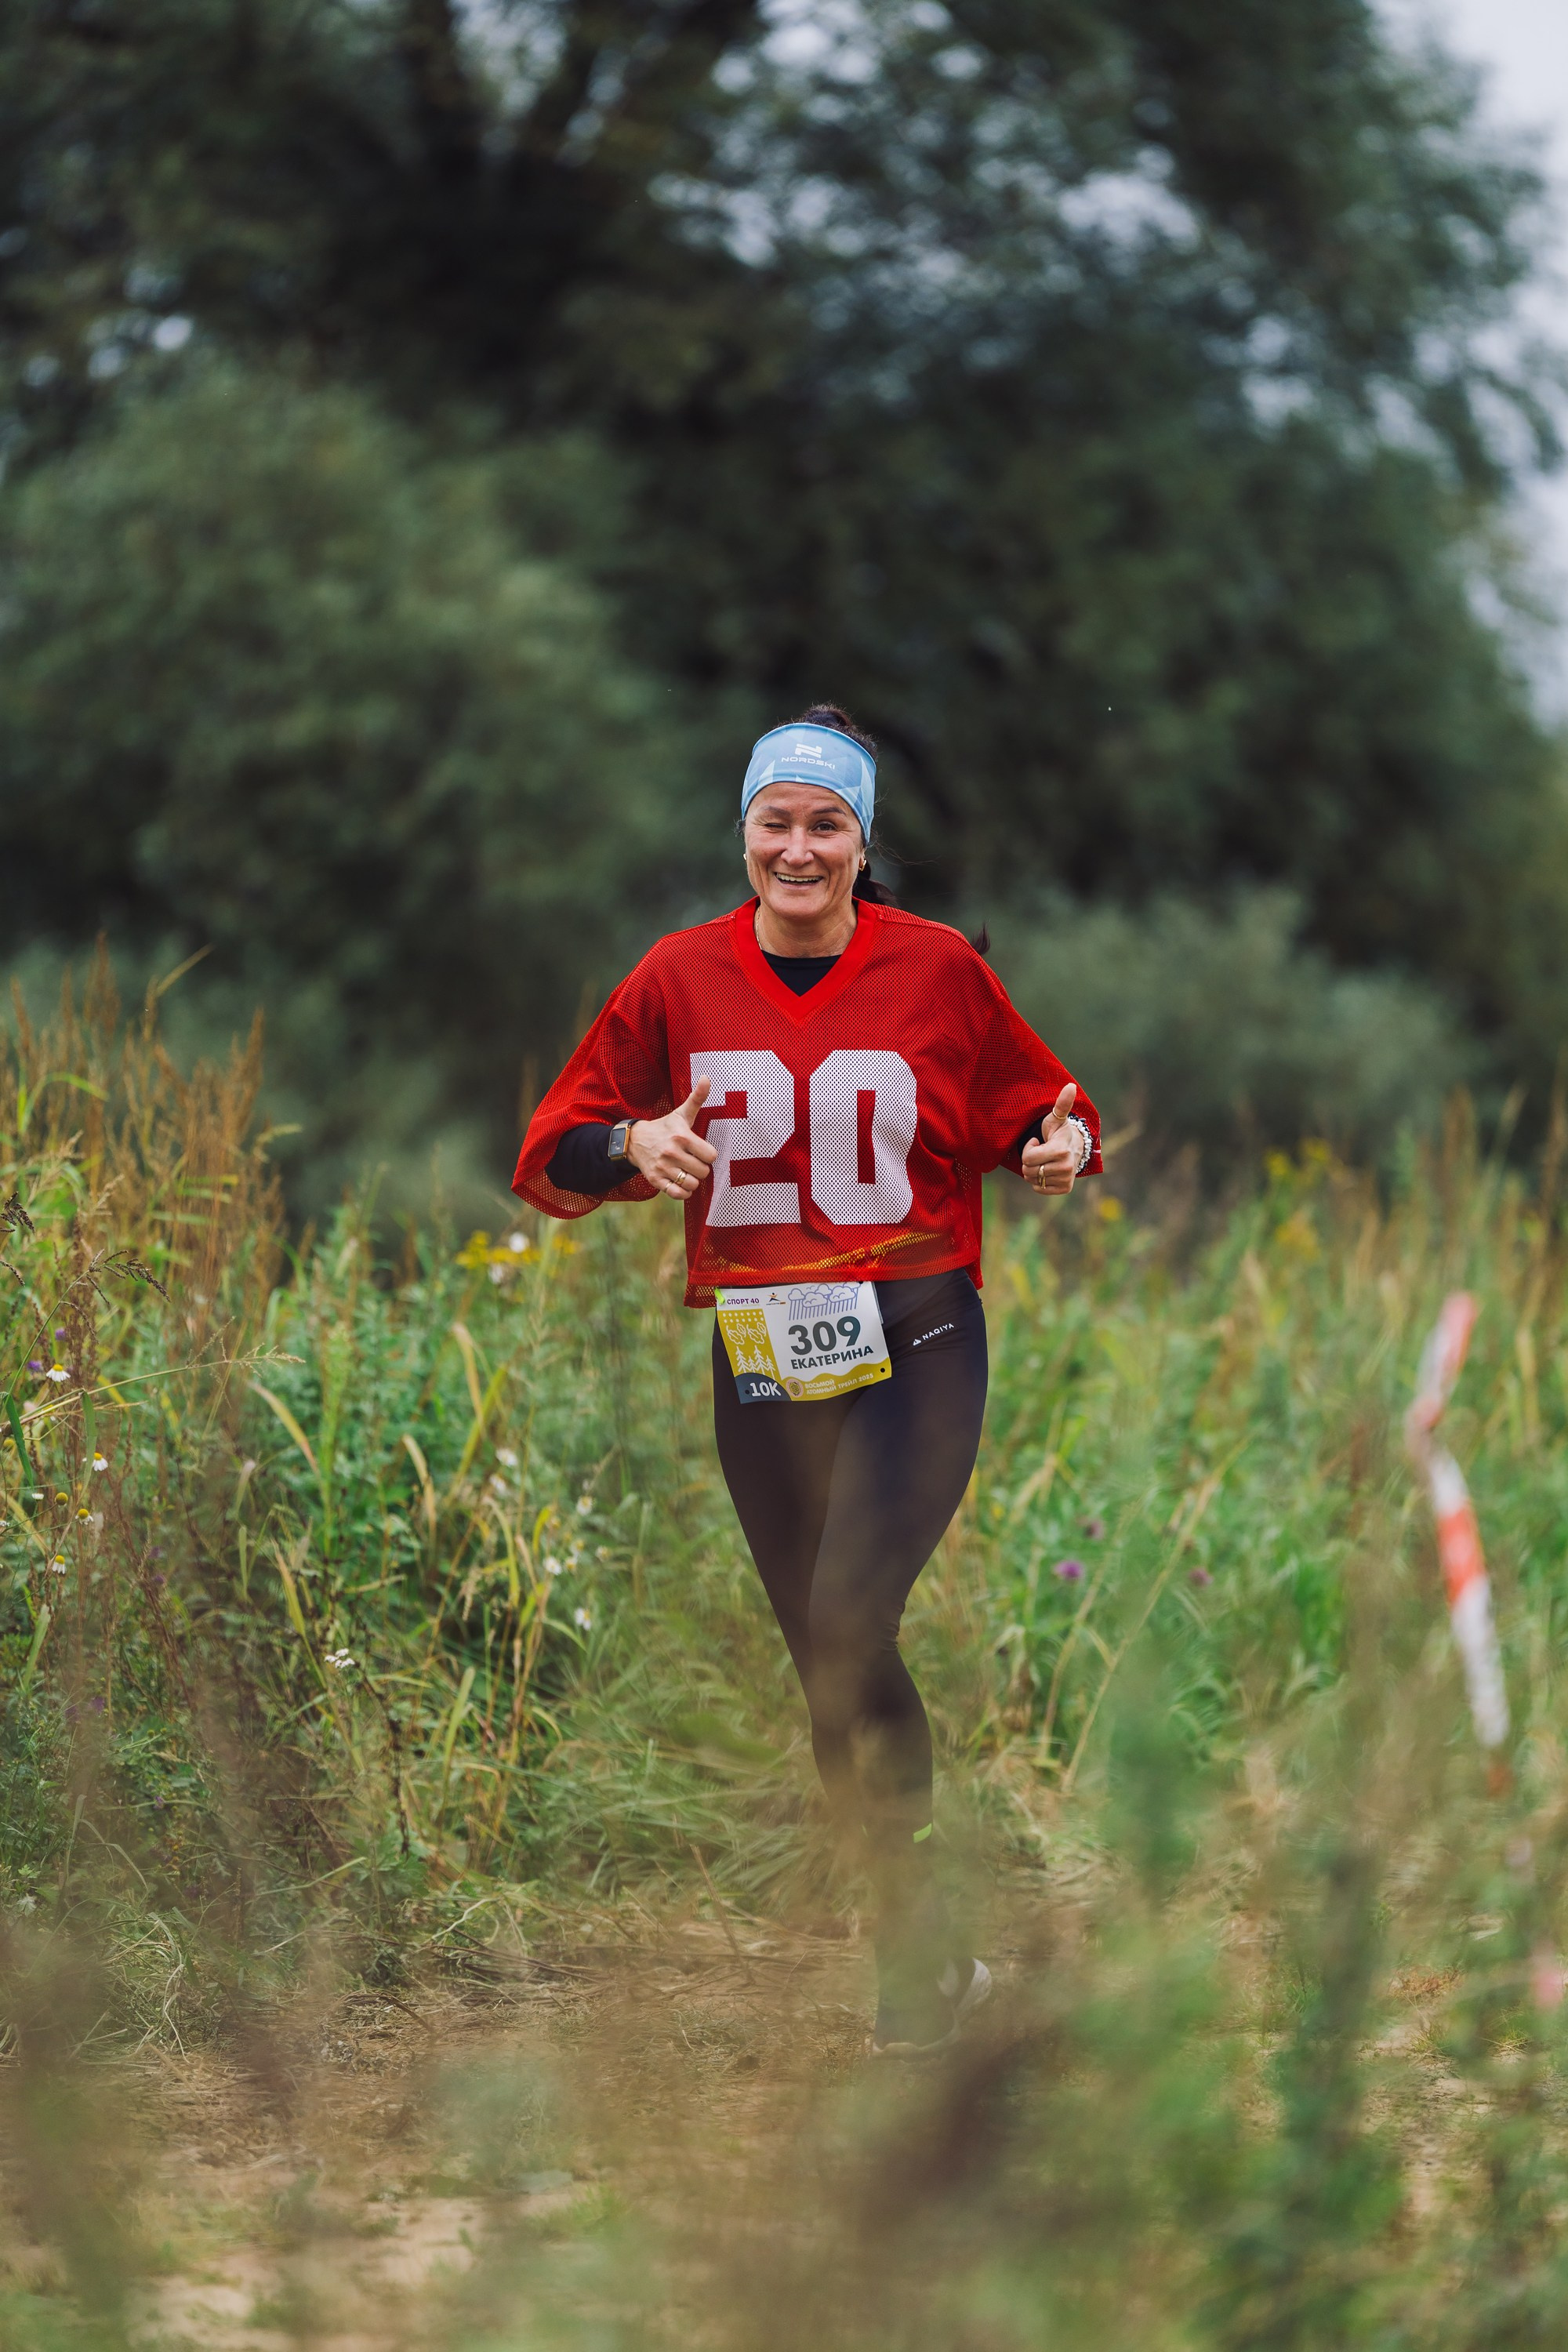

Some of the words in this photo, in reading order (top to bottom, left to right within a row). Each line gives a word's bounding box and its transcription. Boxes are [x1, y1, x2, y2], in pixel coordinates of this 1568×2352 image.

[781, 757, 836, 770] NORDSKI
[690, 1050, 917, 1227] 20
[788, 1316, 861, 1356] 309
[922, 1323, 954, 1340] NAQIYA
[790, 1345, 874, 1370] ЕКАТЕРИНА
[804, 1378, 835, 1389] ВОСЬМОЙ
[806, 1385, 837, 1395] АТОМНЫЙ
[838, 1378, 857, 1389] ТРЕЙЛ
[858, 1373, 874, 1382] 2025
